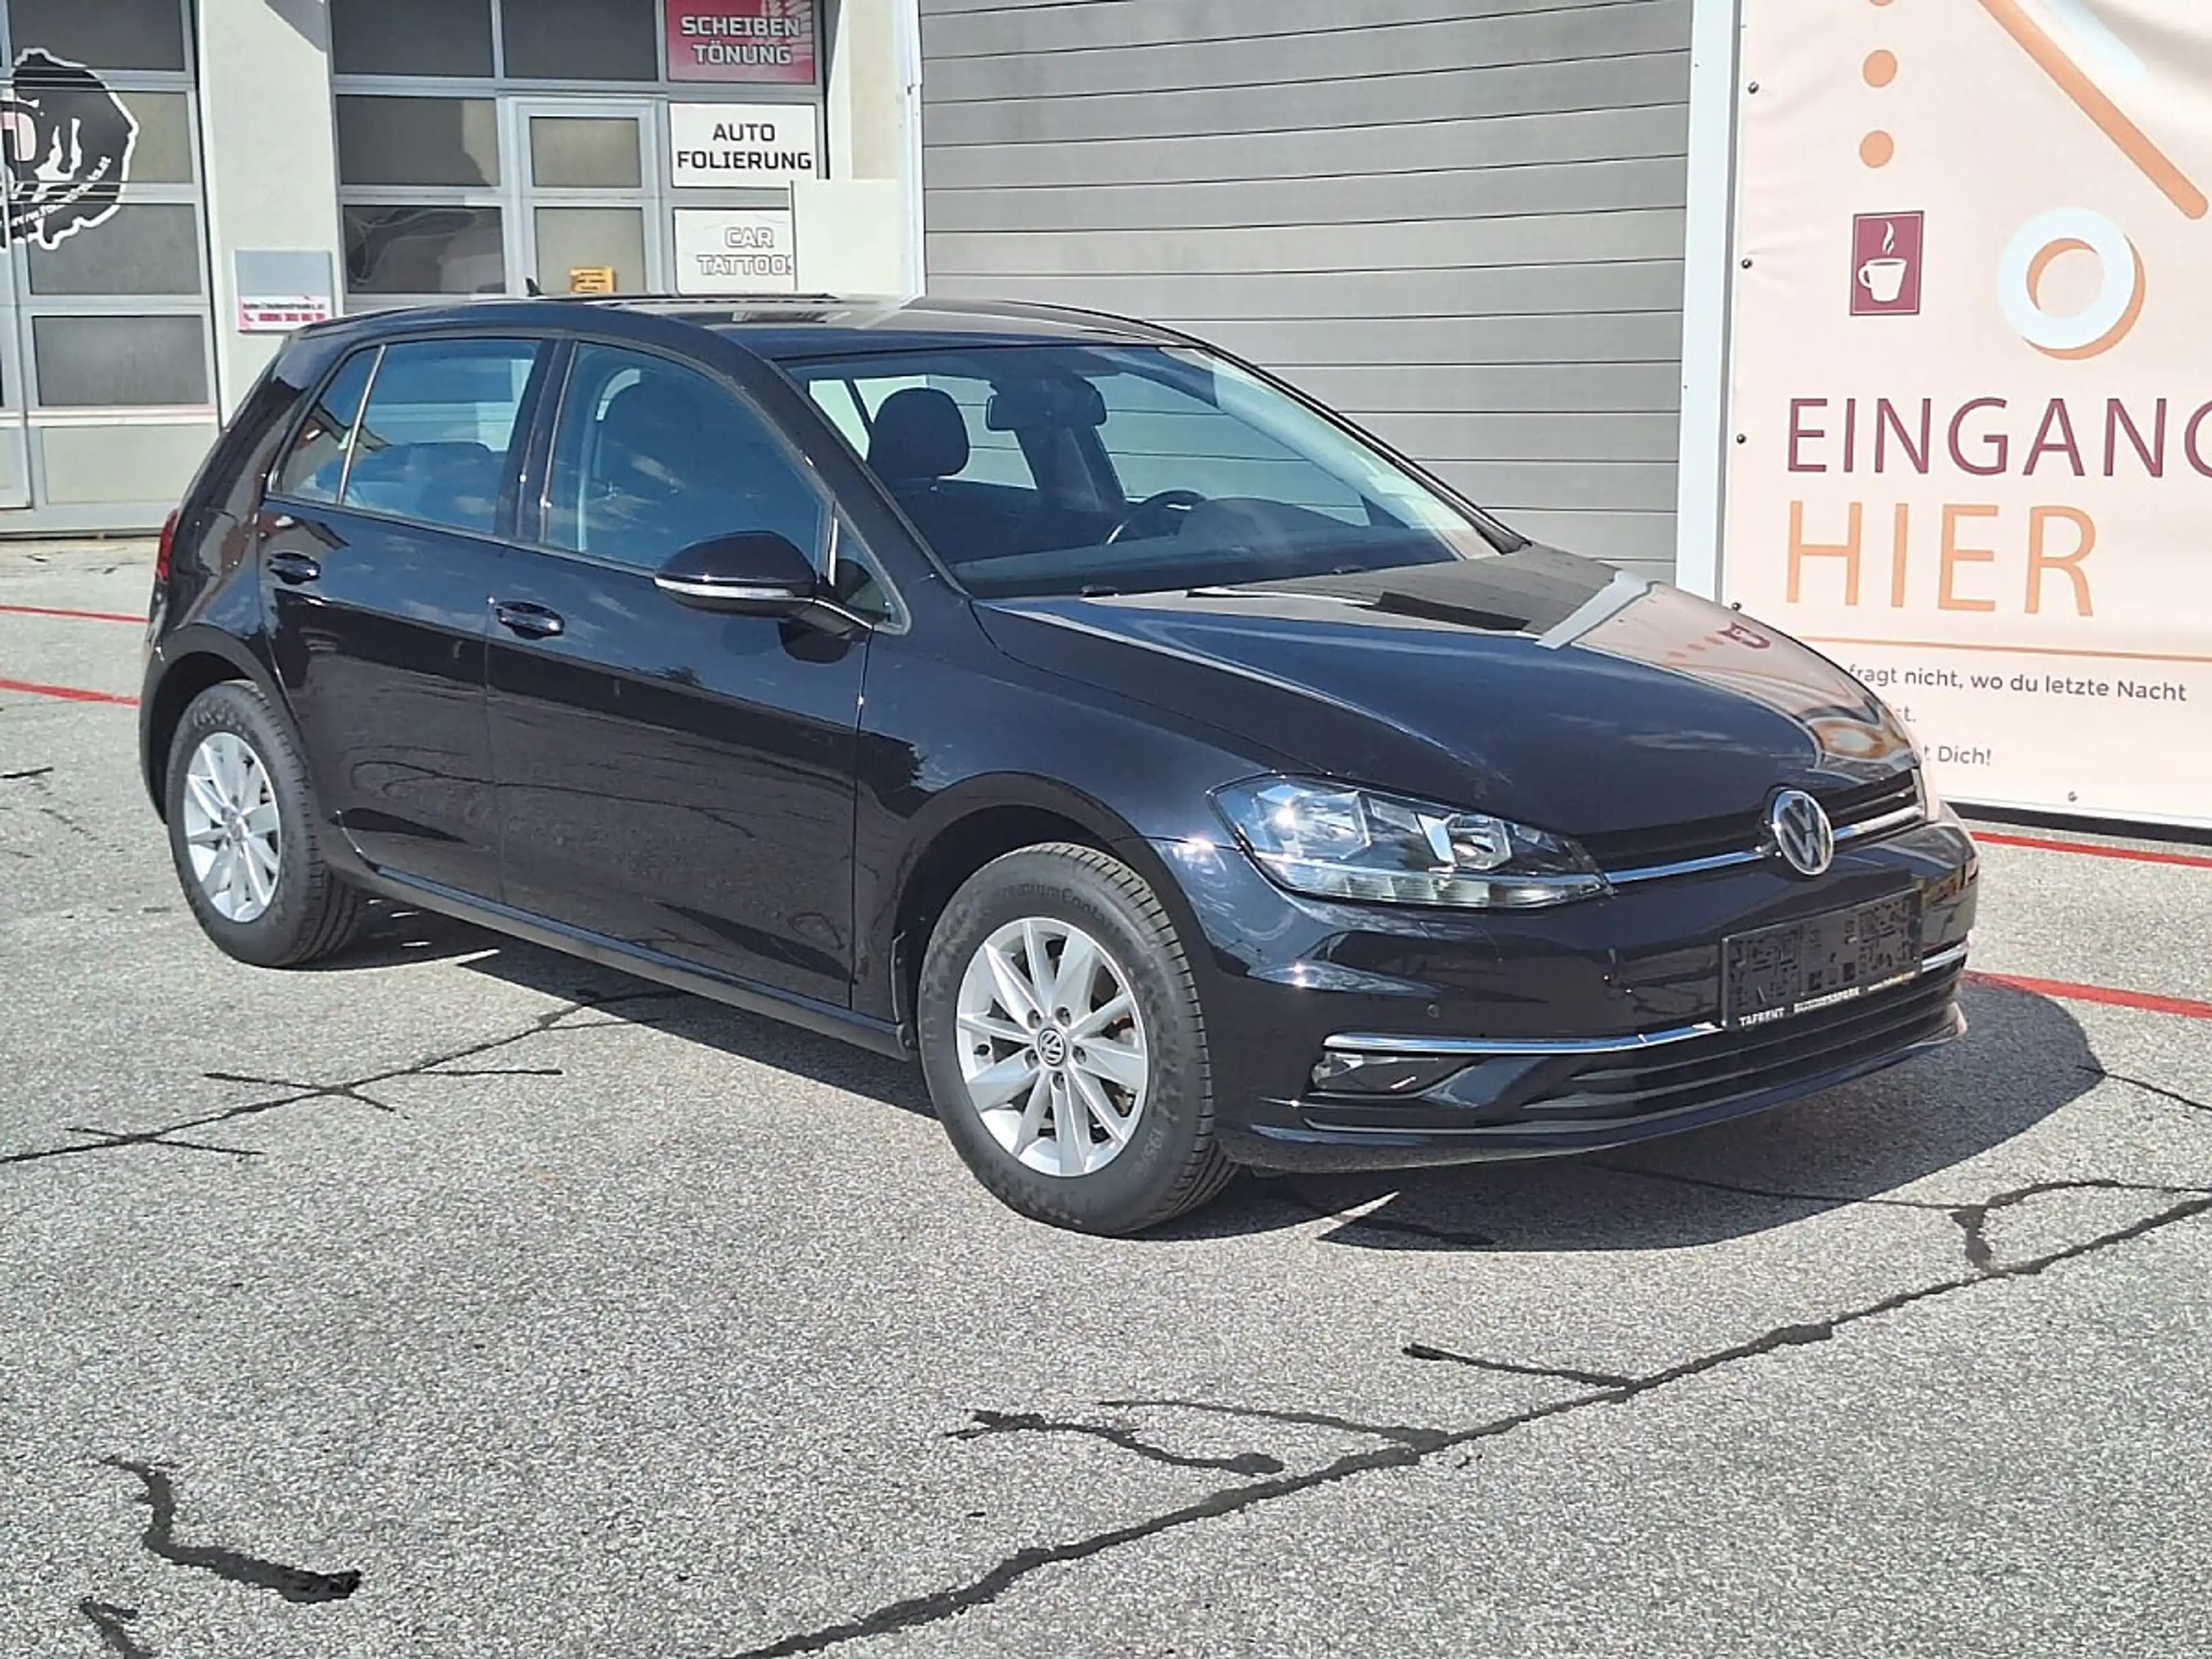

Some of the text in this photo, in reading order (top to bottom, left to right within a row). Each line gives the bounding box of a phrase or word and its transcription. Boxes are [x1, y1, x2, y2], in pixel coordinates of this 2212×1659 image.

[681, 16, 801, 37] SCHEIBEN
[692, 40, 793, 66] TÖNUNG
[712, 123, 775, 142] AUTO
[677, 150, 812, 170] FOLIERUNG
[724, 227, 774, 248] CAR
[1786, 501, 2097, 618] HIER
[1904, 666, 1964, 690] nicht,
[1970, 674, 2003, 690] wo
[2010, 673, 2038, 692] du
[2045, 674, 2110, 697] letzte
[2117, 679, 2188, 702] Nacht
[1938, 745, 1993, 767] Dich!
